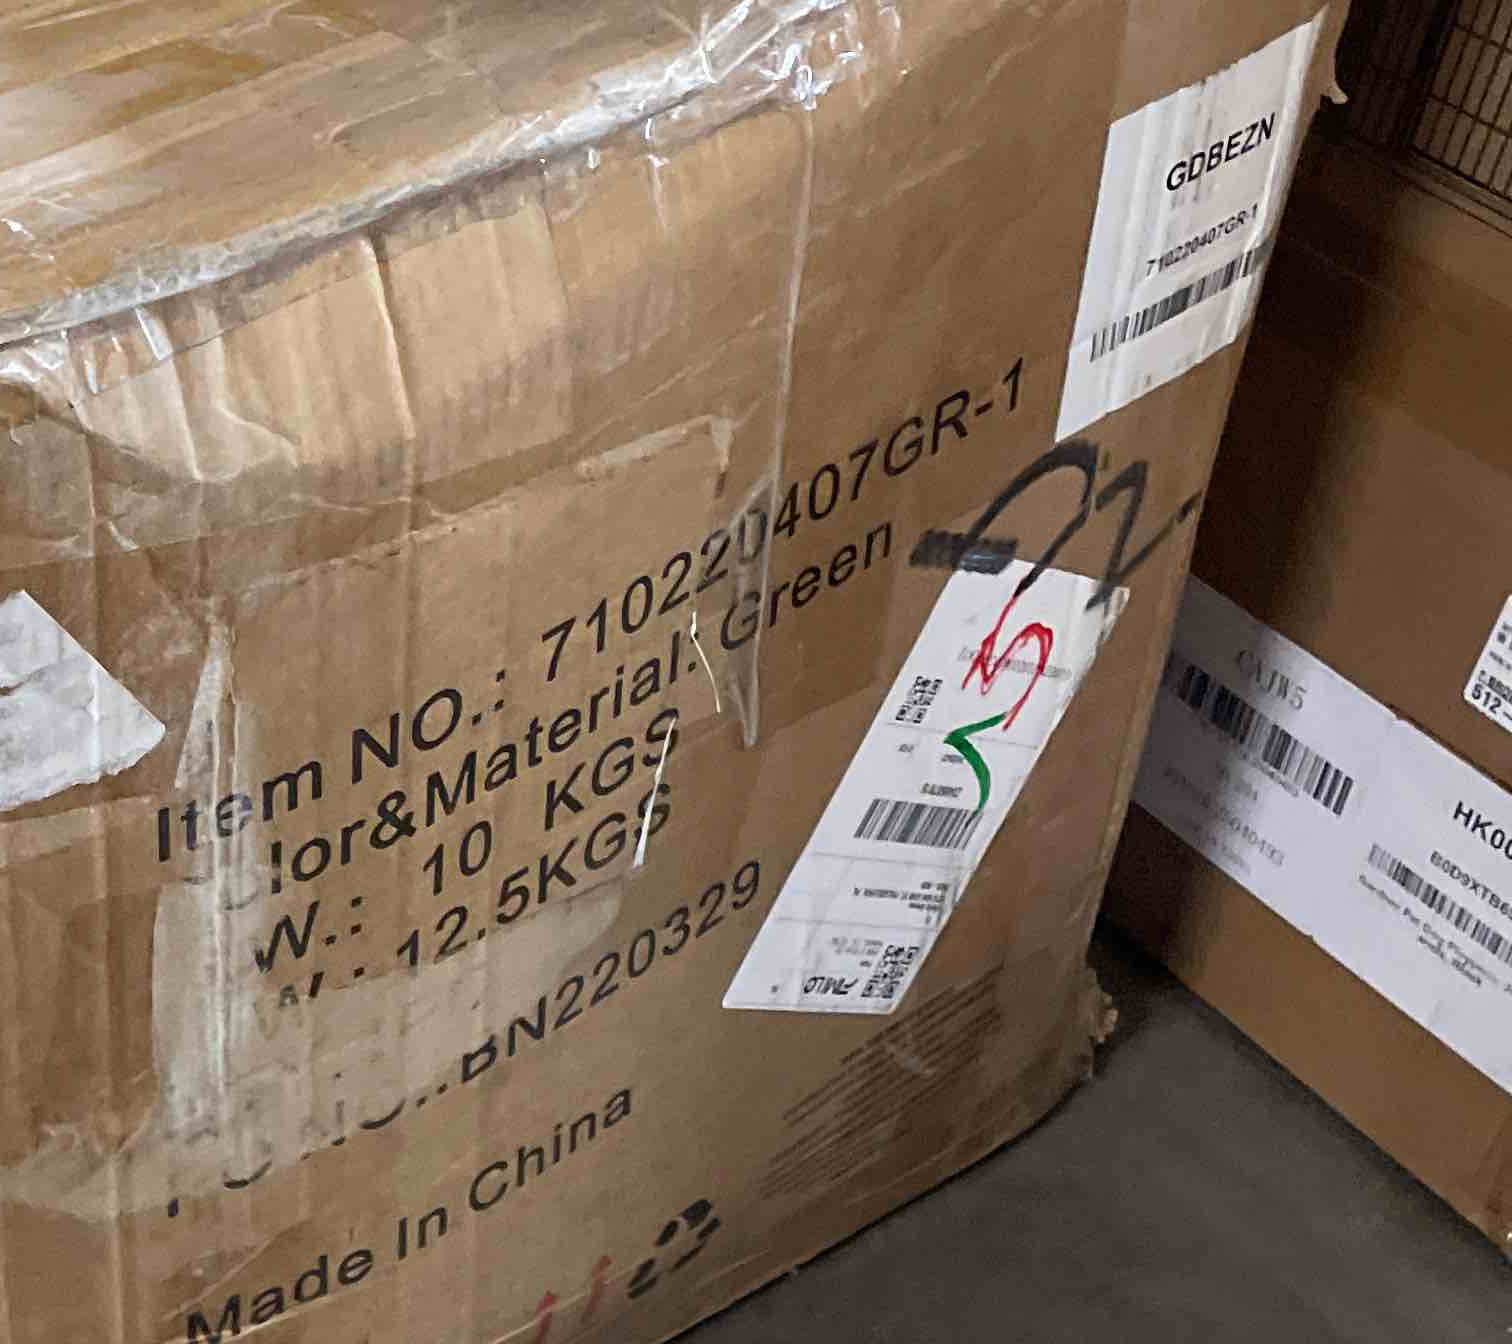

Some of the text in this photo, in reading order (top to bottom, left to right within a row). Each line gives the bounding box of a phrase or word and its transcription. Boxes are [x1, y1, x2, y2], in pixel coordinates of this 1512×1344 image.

[1165, 111, 1276, 193] GDBEZN
[157, 759, 324, 863] Item
[351, 667, 507, 785] NO.:
[540, 356, 1025, 683] 710220407GR-1
[268, 521, 894, 897] lor&Material: Green
[422, 819, 495, 897] 10
[545, 707, 681, 831] KGS
[396, 781, 673, 978] 12.5KGS
[395, 1206, 449, 1262] In
[468, 1087, 634, 1213] China
